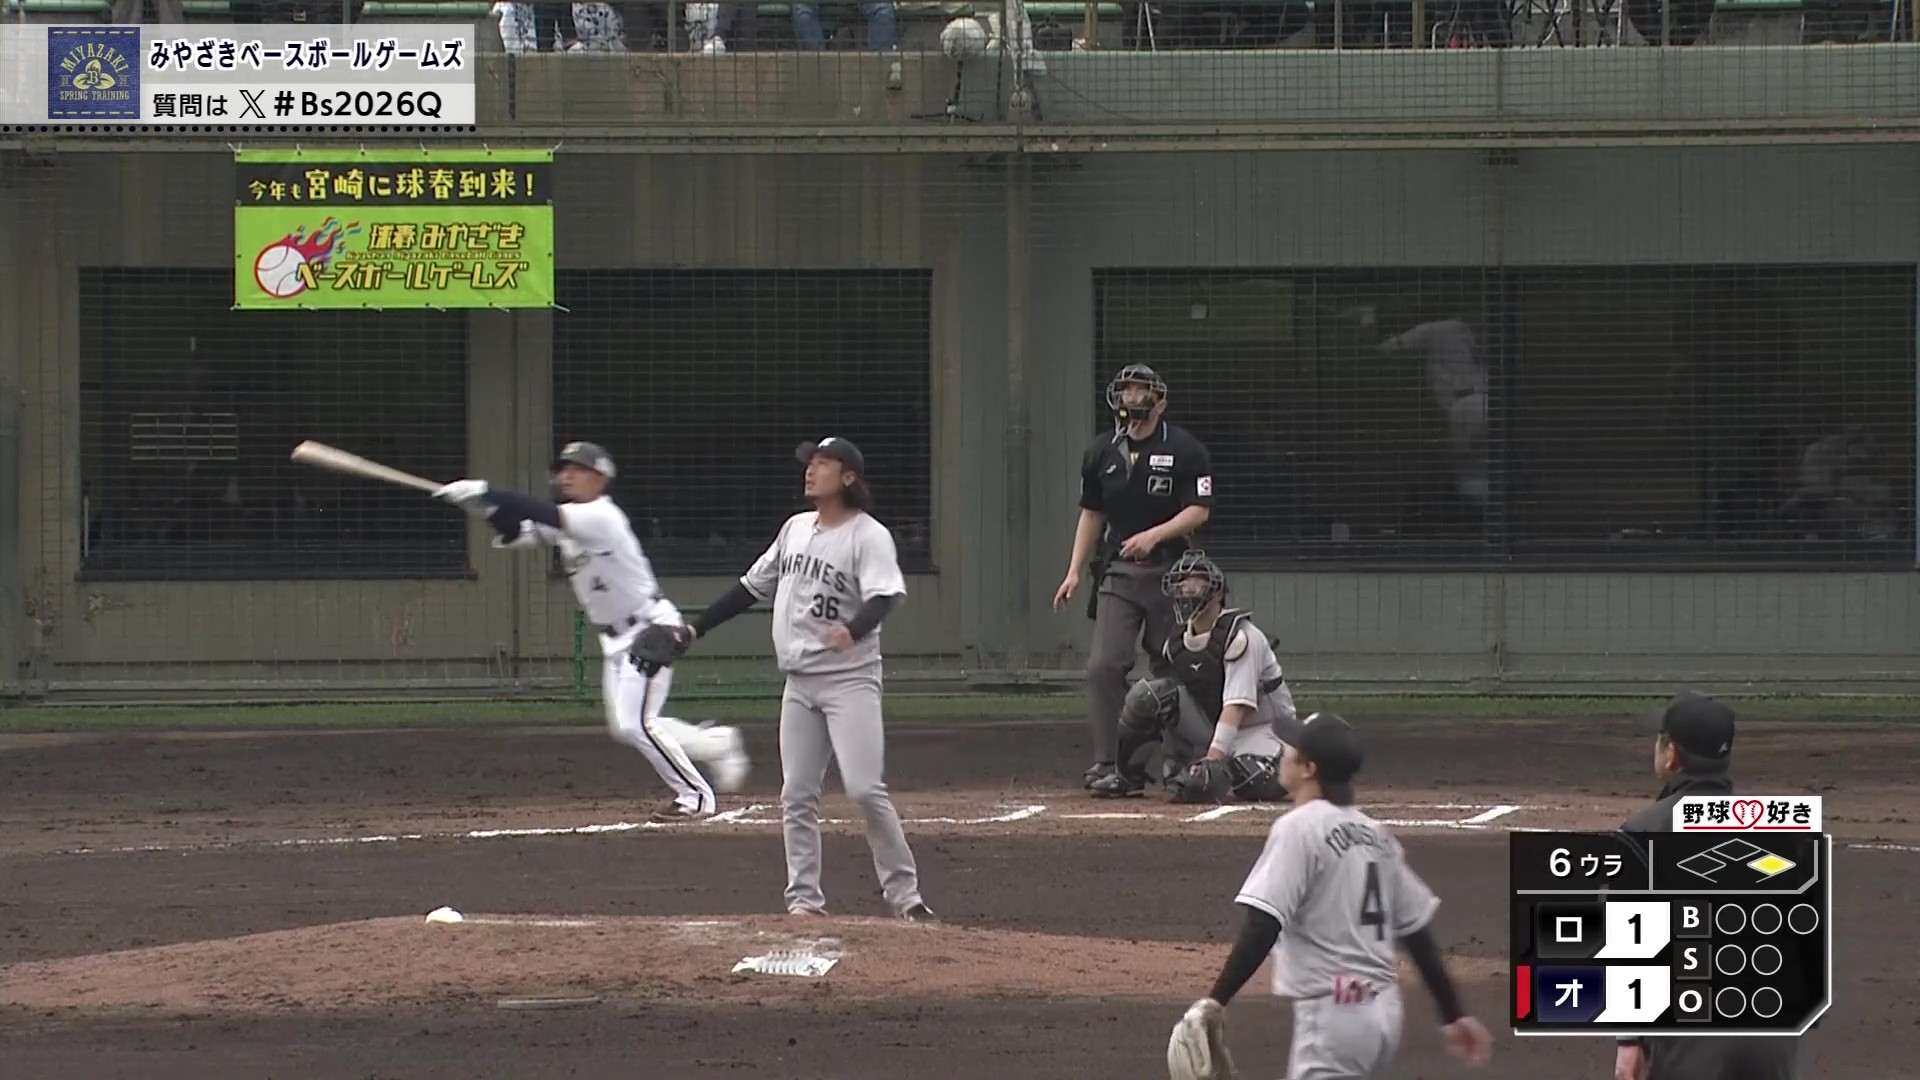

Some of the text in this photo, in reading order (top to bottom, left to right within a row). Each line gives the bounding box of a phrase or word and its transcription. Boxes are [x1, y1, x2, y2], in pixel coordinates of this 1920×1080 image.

[420, 222, 524, 250] みやざき
[296, 261, 529, 290] ベースボールゲームズ
[811, 593, 840, 620] 36
[1360, 861, 1385, 942] 4
